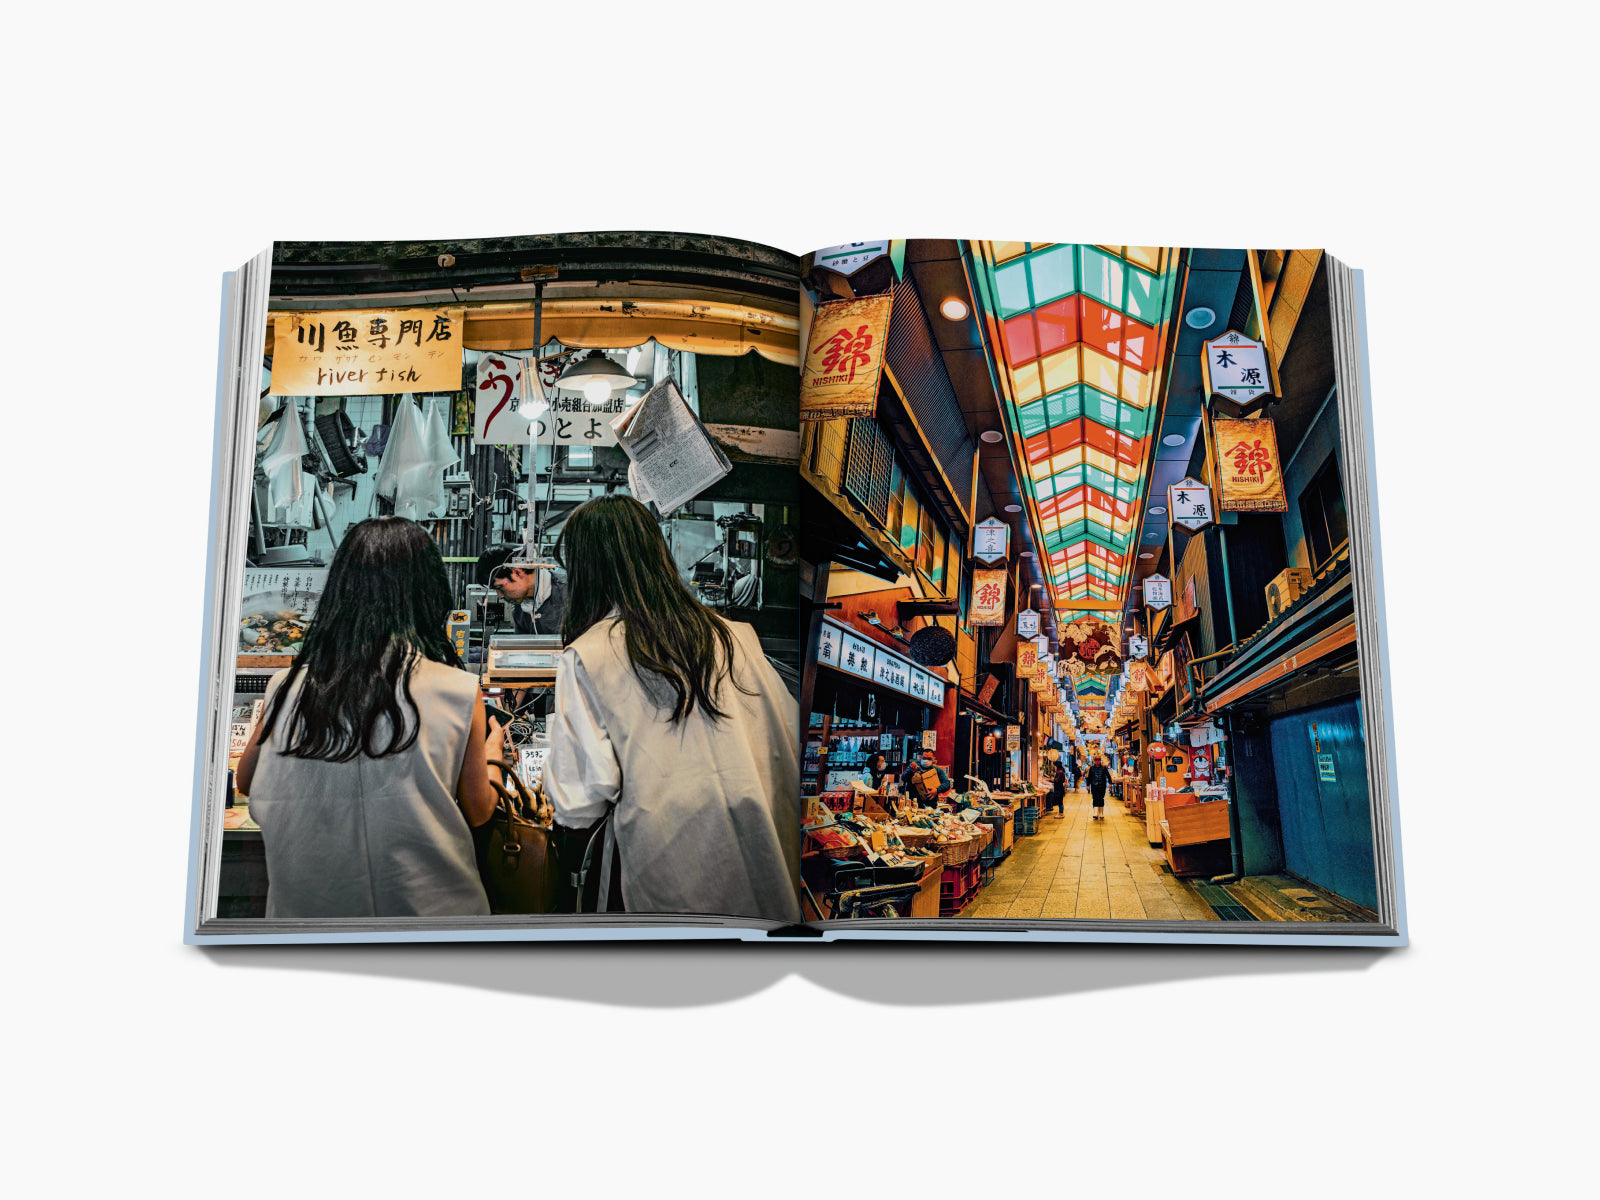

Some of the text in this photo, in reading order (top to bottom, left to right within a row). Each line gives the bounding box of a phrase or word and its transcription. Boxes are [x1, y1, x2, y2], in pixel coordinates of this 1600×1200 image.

[297, 315, 452, 353] 川魚専門店
[812, 324, 873, 385] 錦
[1215, 350, 1262, 386] 木源
[316, 367, 368, 386] river
[812, 374, 849, 387] NISHIKI
[1224, 439, 1273, 485] 錦
[976, 583, 1001, 610] 錦
